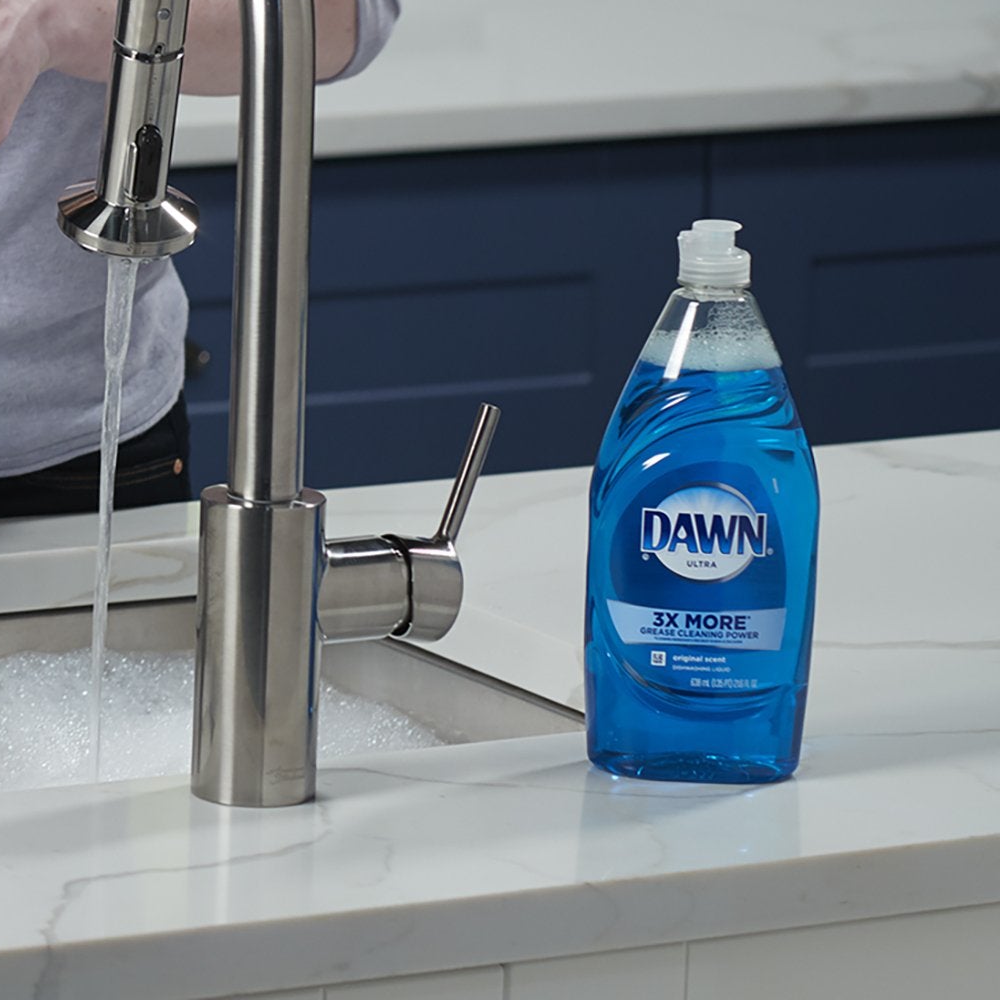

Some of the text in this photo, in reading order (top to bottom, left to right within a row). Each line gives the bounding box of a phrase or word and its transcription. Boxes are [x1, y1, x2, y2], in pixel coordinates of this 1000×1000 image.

[641, 508, 767, 556] DAWN
[686, 560, 718, 569] ULTRA
[652, 611, 679, 628] 3X
[640, 626, 676, 638] GREASE
[677, 629, 724, 639] CLEANING
[725, 631, 759, 640] POWER
[672, 654, 704, 664] original
[704, 655, 727, 664] scent
